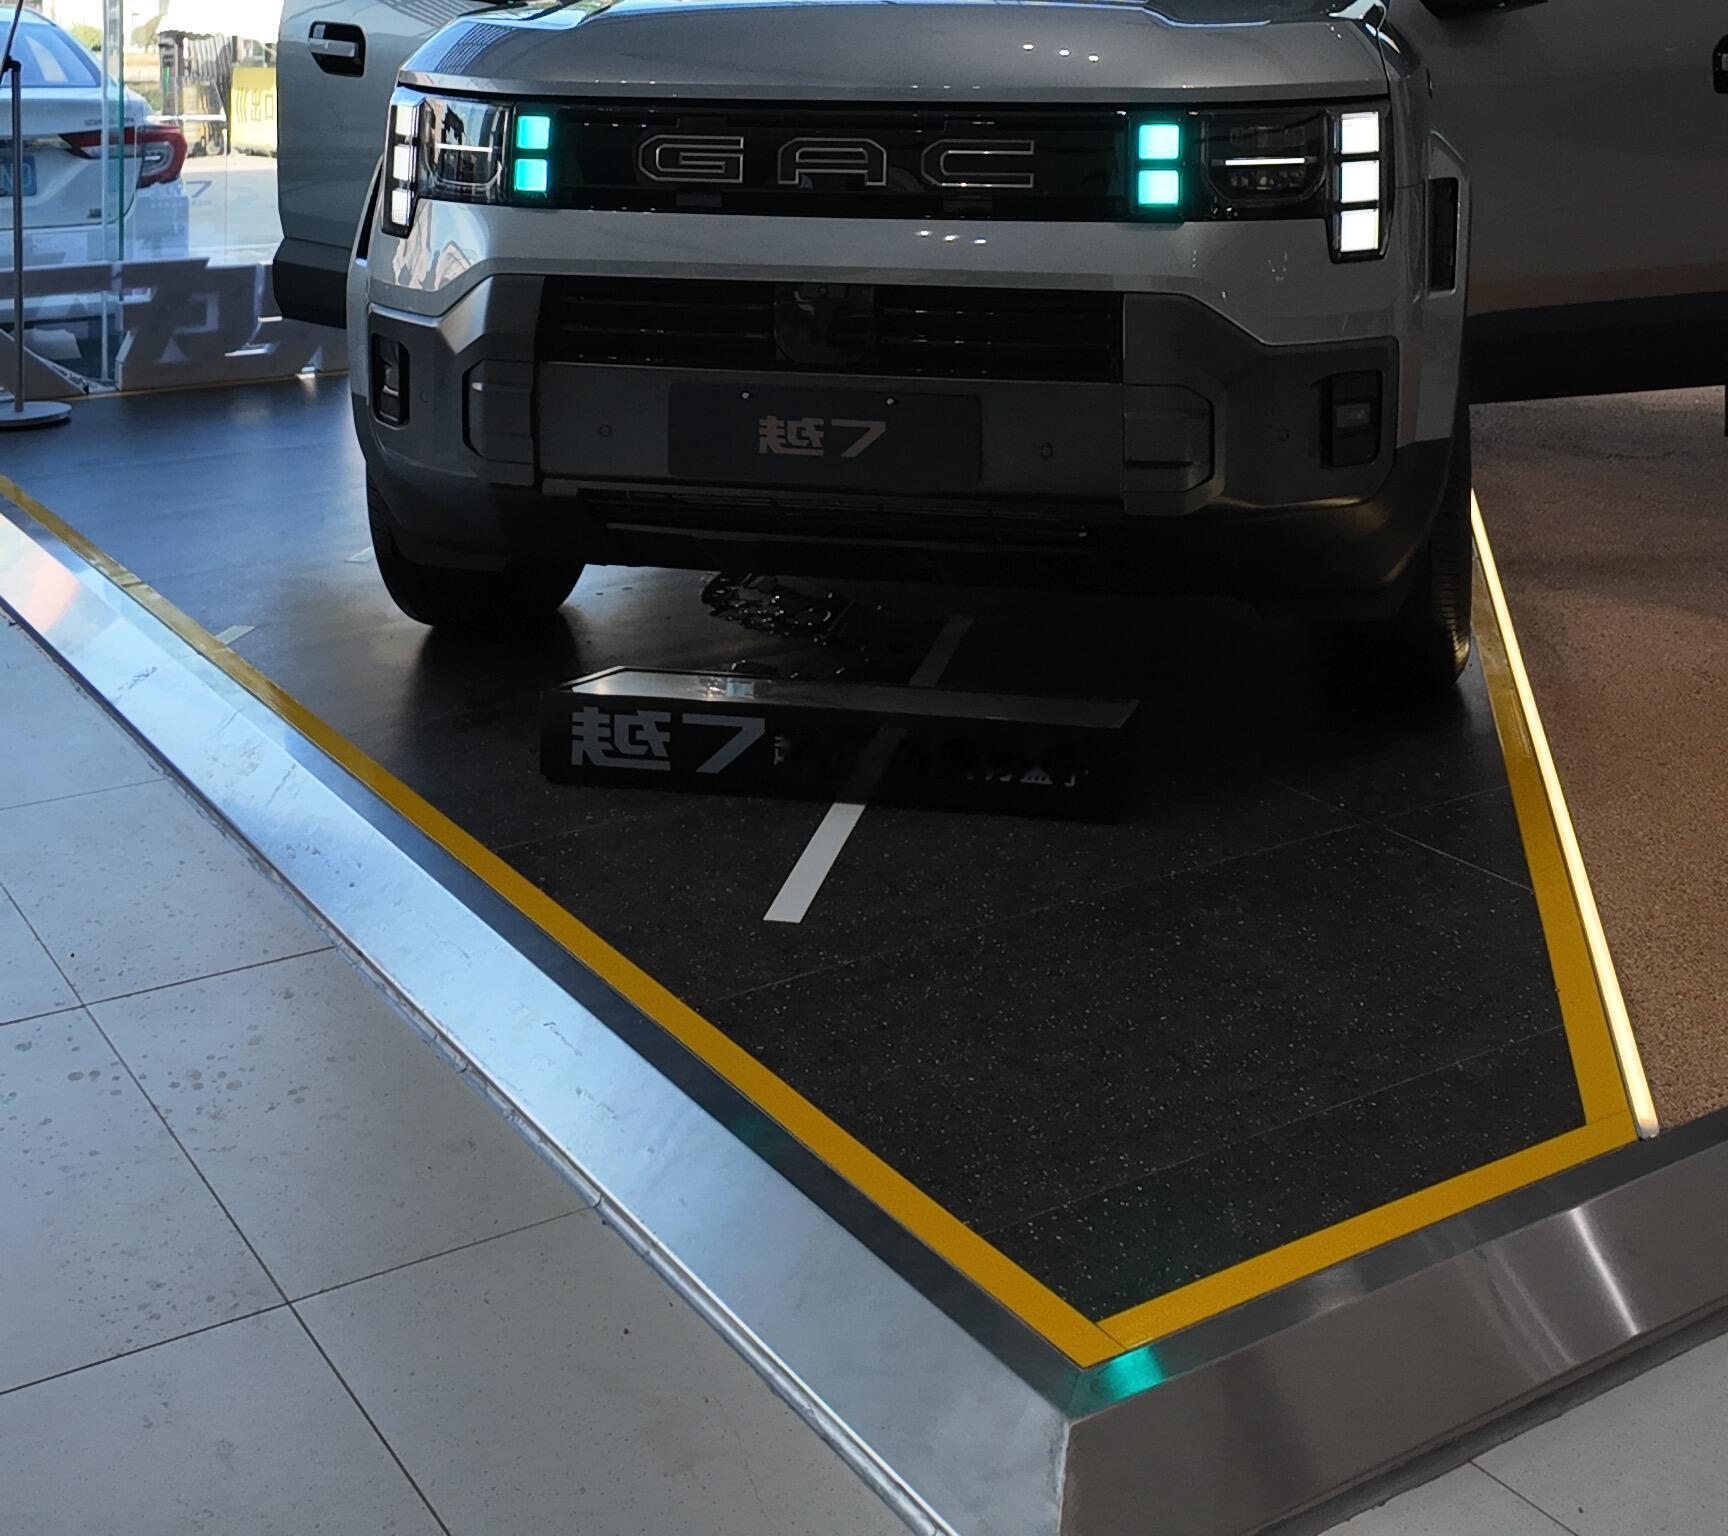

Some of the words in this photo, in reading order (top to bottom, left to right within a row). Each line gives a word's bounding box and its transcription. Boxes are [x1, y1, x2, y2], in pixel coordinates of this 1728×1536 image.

[638, 134, 1035, 188] GAC
[759, 415, 887, 458] 越7
[571, 706, 766, 774] 越7
